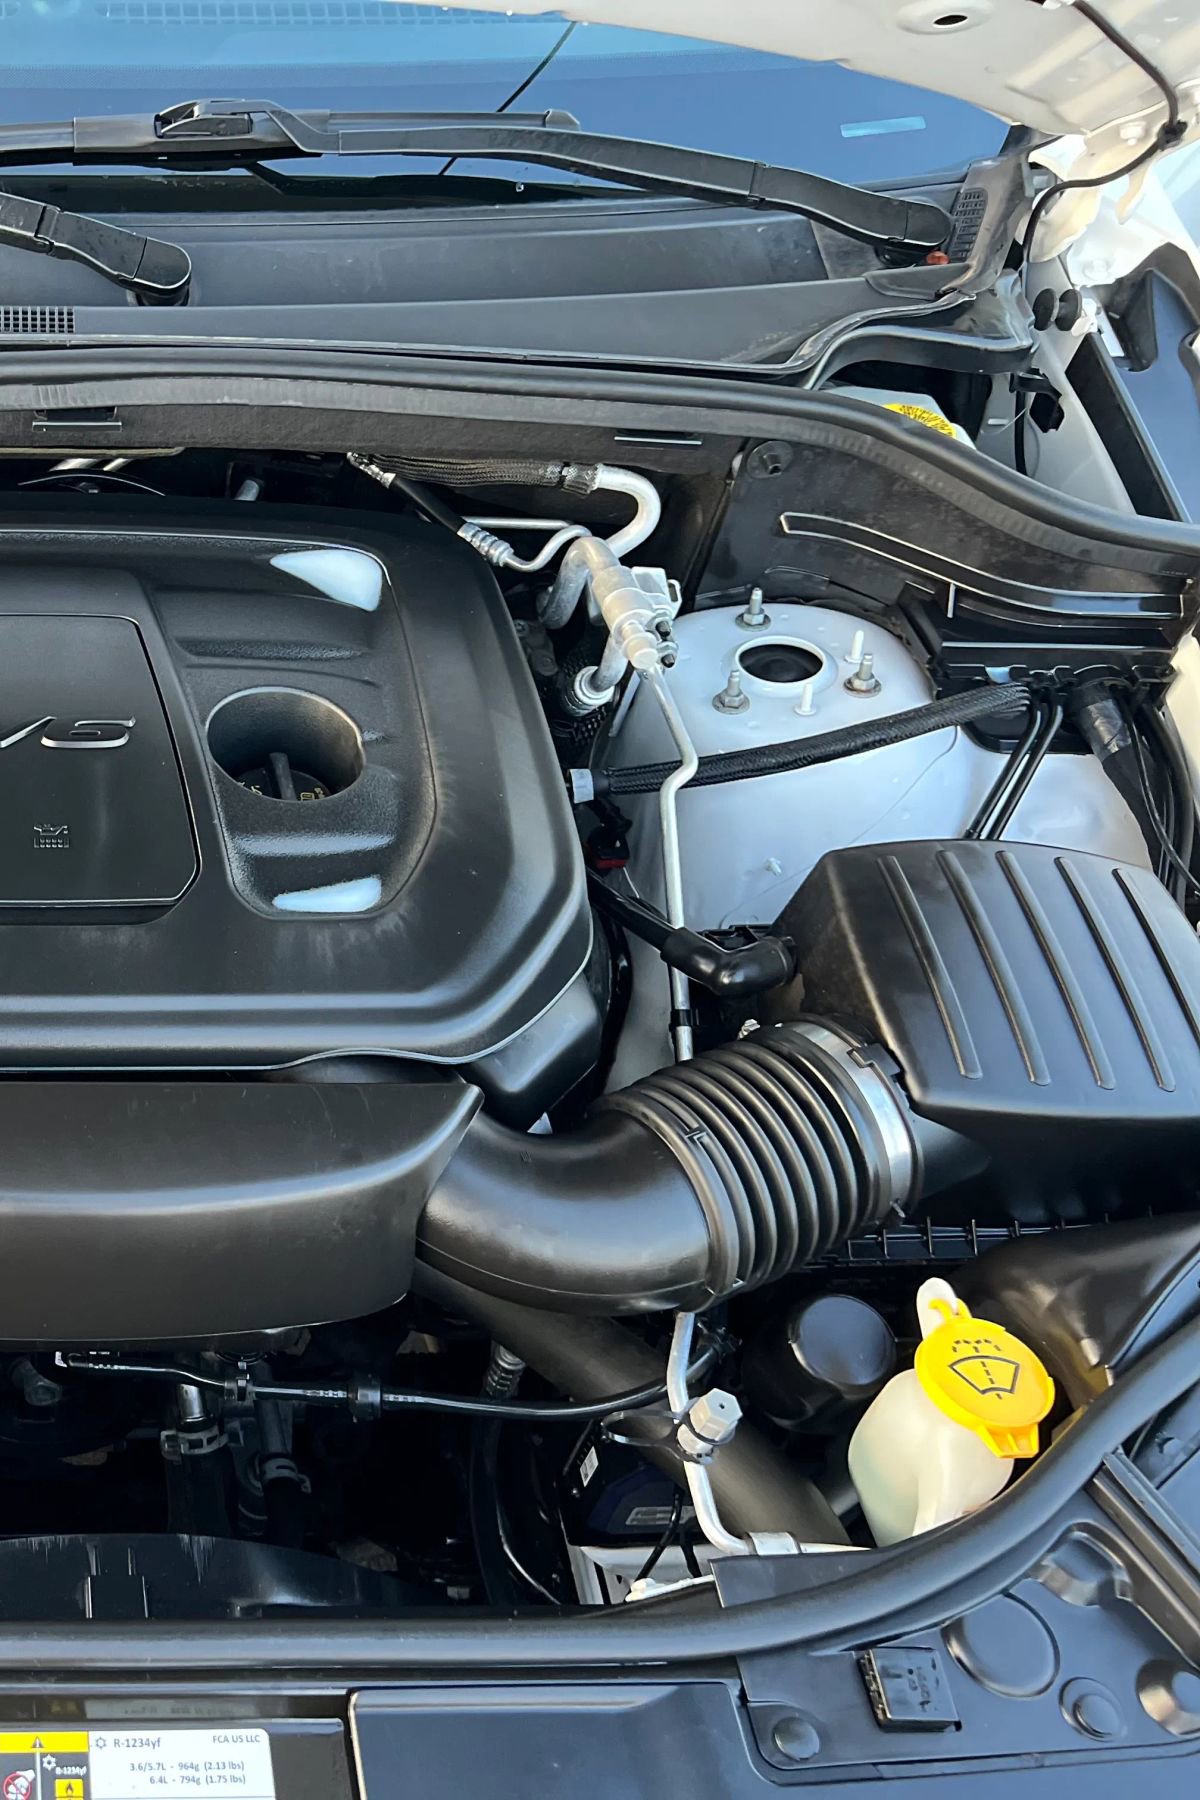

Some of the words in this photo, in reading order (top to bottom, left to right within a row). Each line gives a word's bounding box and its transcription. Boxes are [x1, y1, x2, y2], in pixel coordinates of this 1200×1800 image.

[113, 1737, 161, 1750] R-1234yf
[212, 1735, 229, 1744] FCA
[231, 1735, 244, 1744] US
[245, 1734, 261, 1743] LLC
[129, 1762, 167, 1772] 3.6/5.7L
[178, 1762, 200, 1773] 964g
[204, 1761, 226, 1772] (2.13
[228, 1761, 245, 1772] lbs)
[149, 1775, 169, 1785] 6.4L
[180, 1775, 201, 1786] 794g
[205, 1774, 228, 1785] (1.75
[229, 1774, 246, 1785] lbs)
